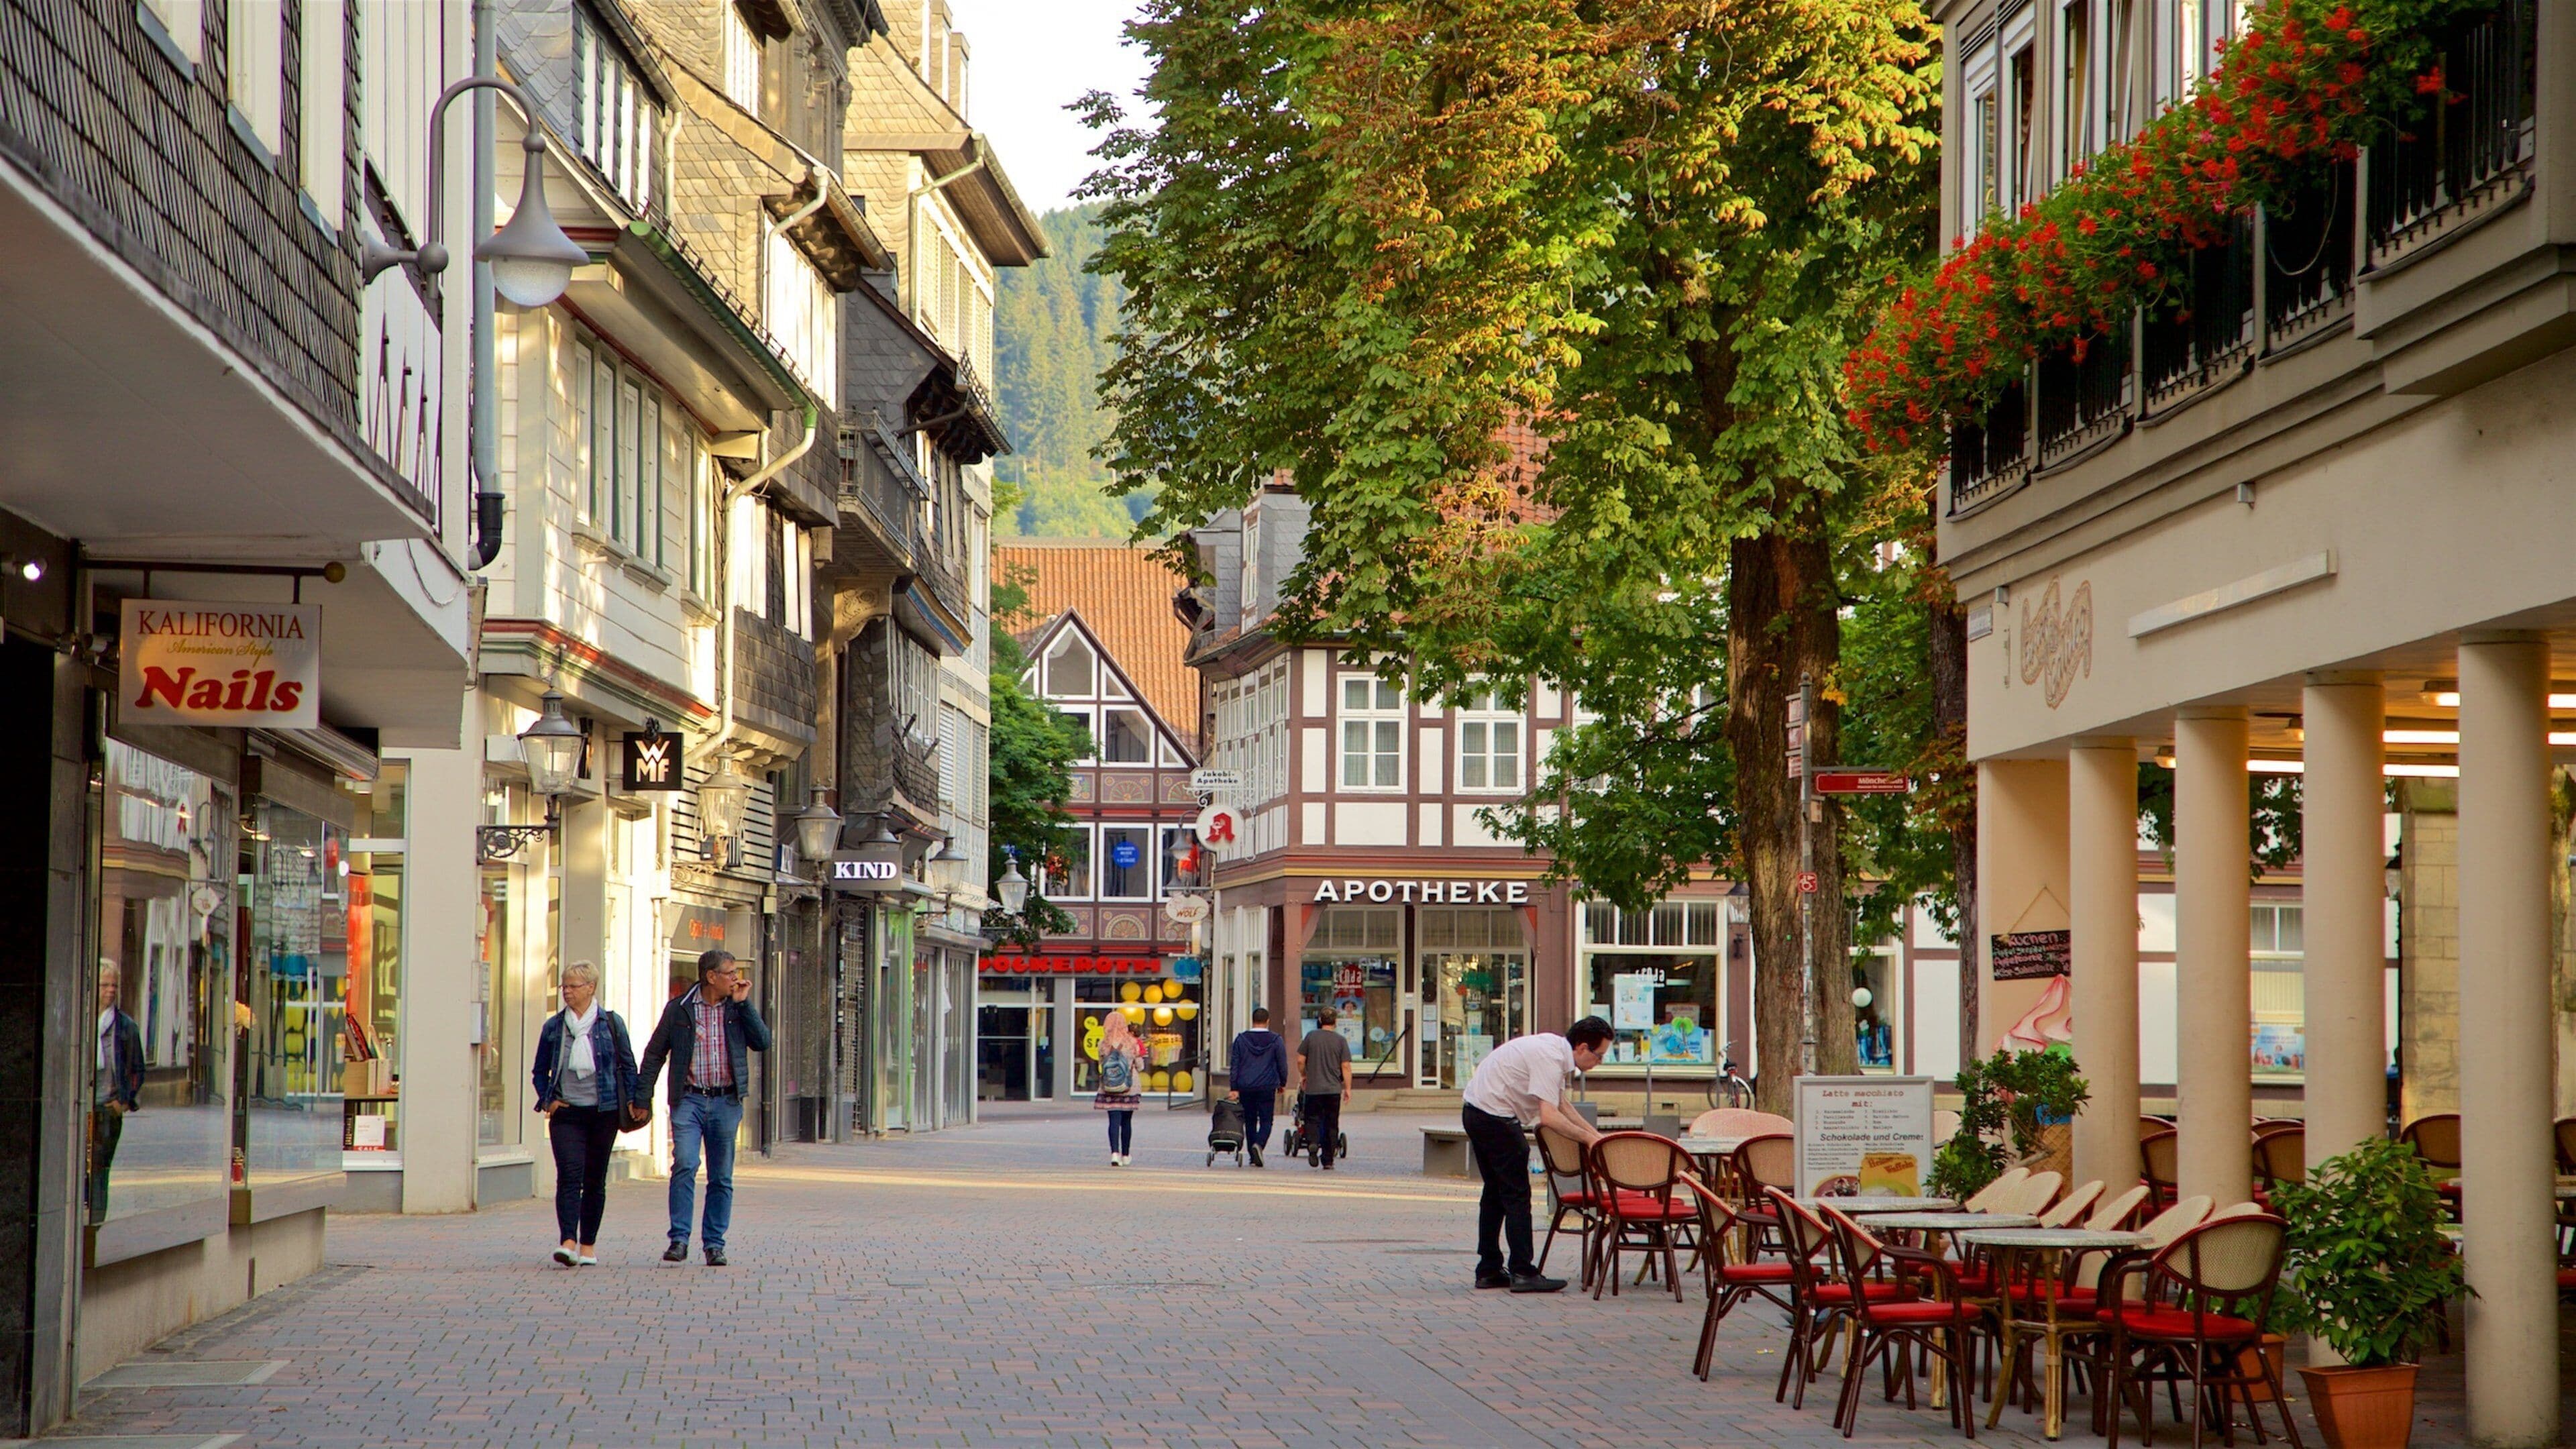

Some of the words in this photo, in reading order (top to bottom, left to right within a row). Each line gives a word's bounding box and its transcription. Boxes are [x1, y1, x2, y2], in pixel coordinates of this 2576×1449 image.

[138, 610, 305, 639] KALIFORNIA
[167, 638, 233, 655] American
[235, 639, 274, 668] Style
[134, 666, 303, 712] Nails
[634, 740, 670, 782] WMF
[834, 861, 897, 879] KIND
[1313, 879, 1529, 904] APOTHEKE
[1820, 1133, 1871, 1141] Schokolade
[1873, 1133, 1890, 1141] und
[1892, 1132, 1924, 1141] Creme:
